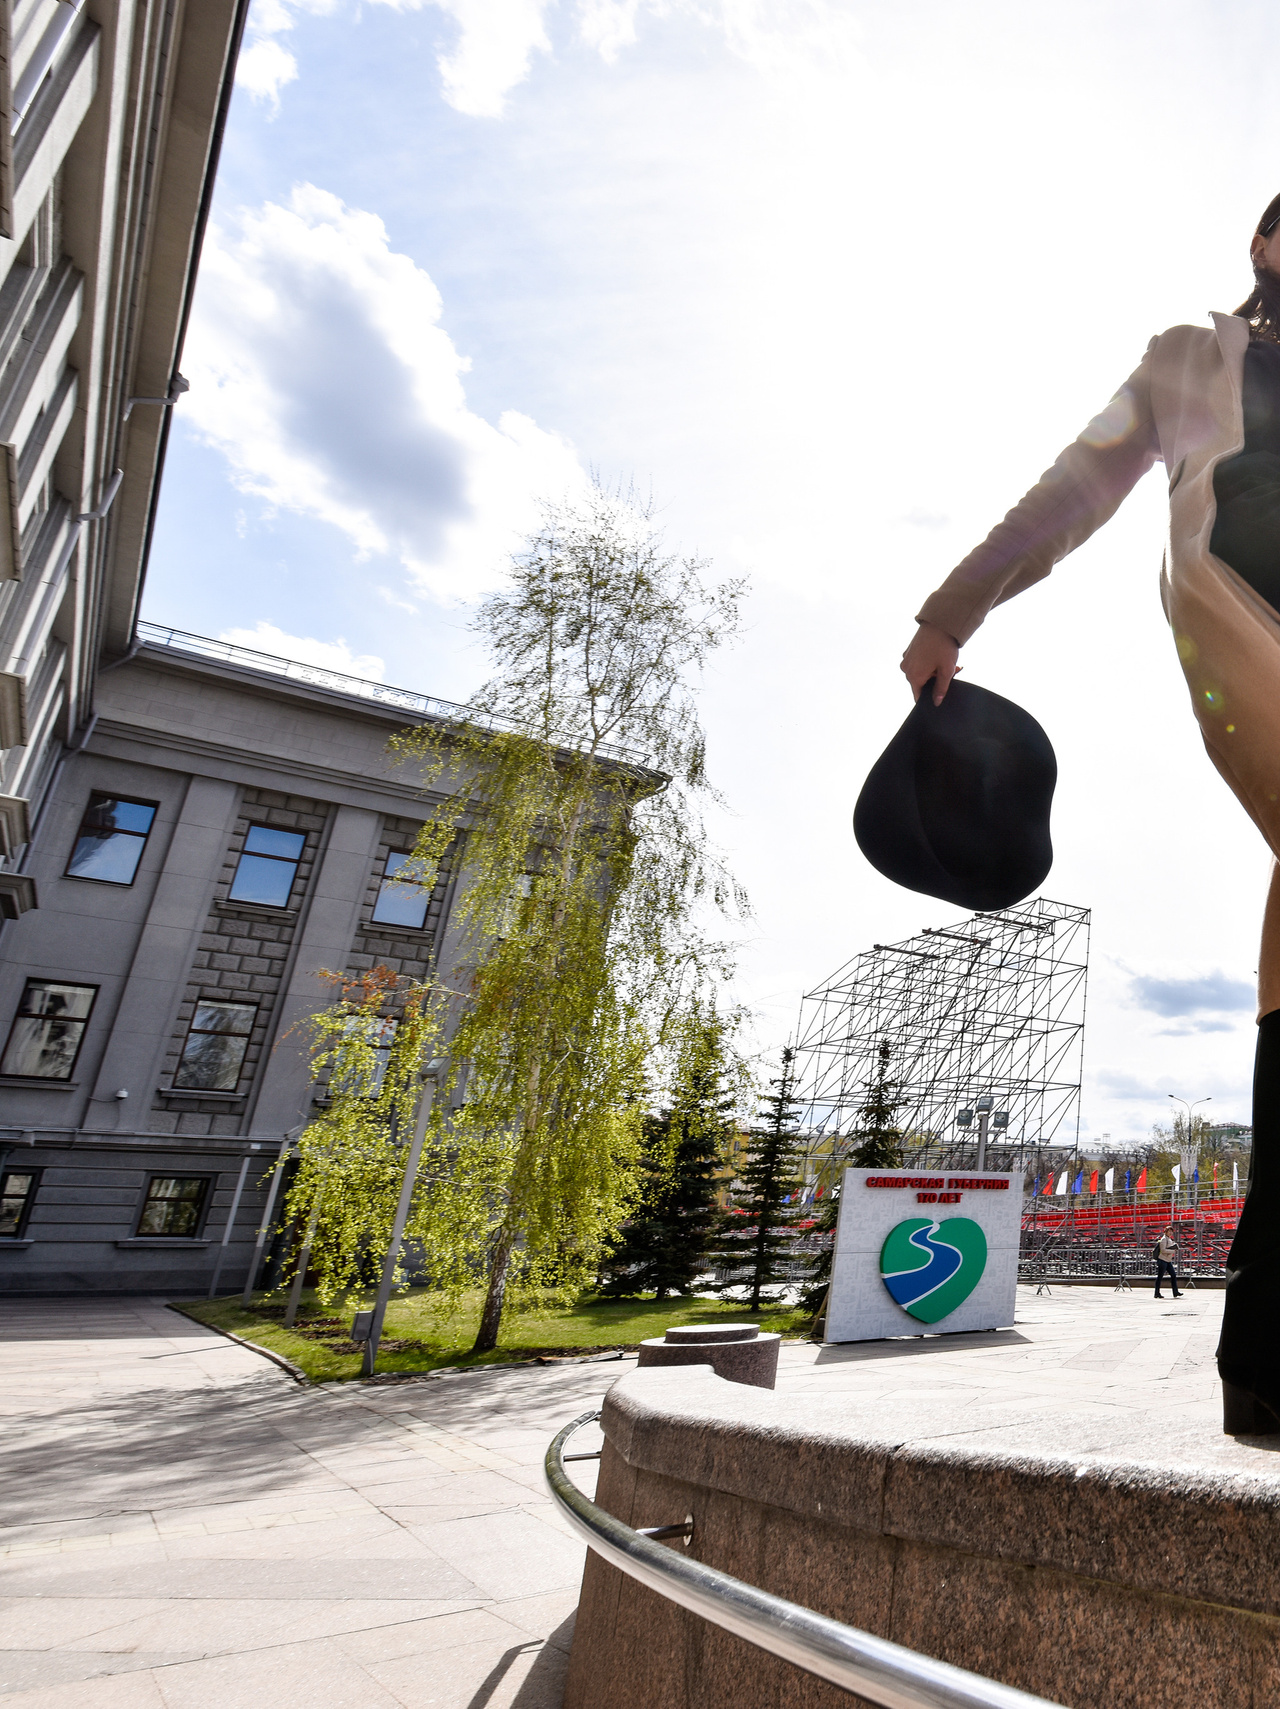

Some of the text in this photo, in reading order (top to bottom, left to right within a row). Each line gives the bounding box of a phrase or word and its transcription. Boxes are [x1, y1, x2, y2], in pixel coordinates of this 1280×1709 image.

[866, 1176, 1009, 1189] САМАРСКАЯ ГУБЕРНИЯ
[916, 1192, 963, 1203] 170 ЛЕТ
